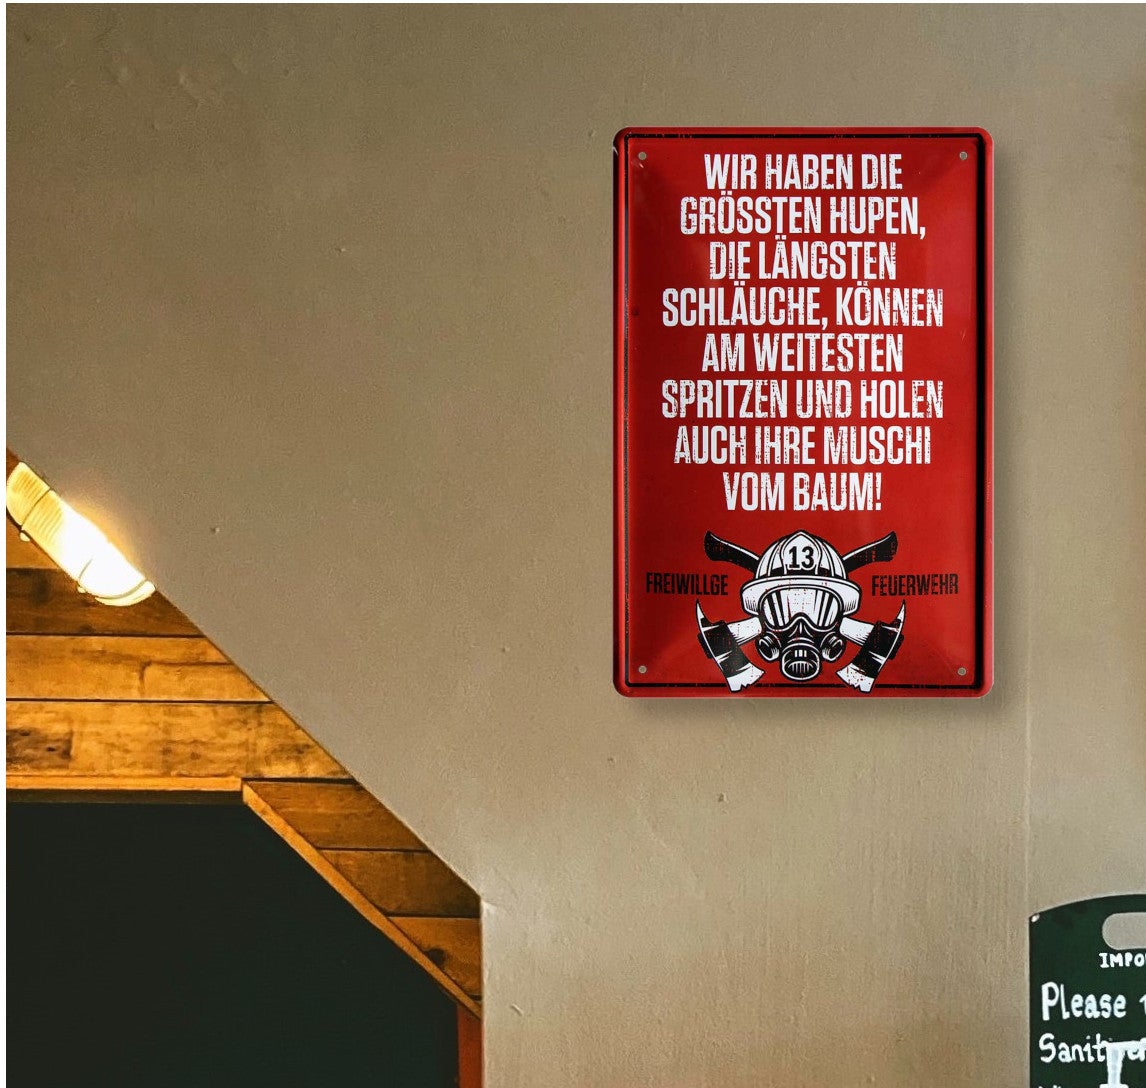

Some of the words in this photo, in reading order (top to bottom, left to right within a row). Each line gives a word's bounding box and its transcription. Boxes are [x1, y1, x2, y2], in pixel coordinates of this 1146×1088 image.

[704, 153, 758, 190] WIR
[765, 153, 854, 190] HABEN
[861, 153, 903, 190] DIE
[680, 190, 822, 236] GRÖSSTEN
[829, 196, 926, 240] HUPEN,
[709, 241, 751, 280] DIE
[758, 234, 896, 280] LÄNGSTEN
[662, 280, 828, 331] SCHLÄUCHE,
[836, 280, 944, 328] KÖNNEN
[701, 332, 745, 372] AM
[753, 332, 904, 373] WEITESTEN
[661, 379, 788, 419] SPRITZEN
[795, 379, 853, 419] UND
[860, 379, 944, 419] HOLEN
[673, 425, 747, 465] AUCH
[754, 425, 816, 465] IHRE
[823, 425, 931, 465] MUSCHI
[722, 471, 785, 511] VOM
[793, 471, 882, 512] BAUM!
[788, 545, 815, 569] 13
[645, 572, 729, 597] FREIWILLGE
[871, 573, 959, 597] FEUERWEHR
[1041, 981, 1127, 1021] Please
